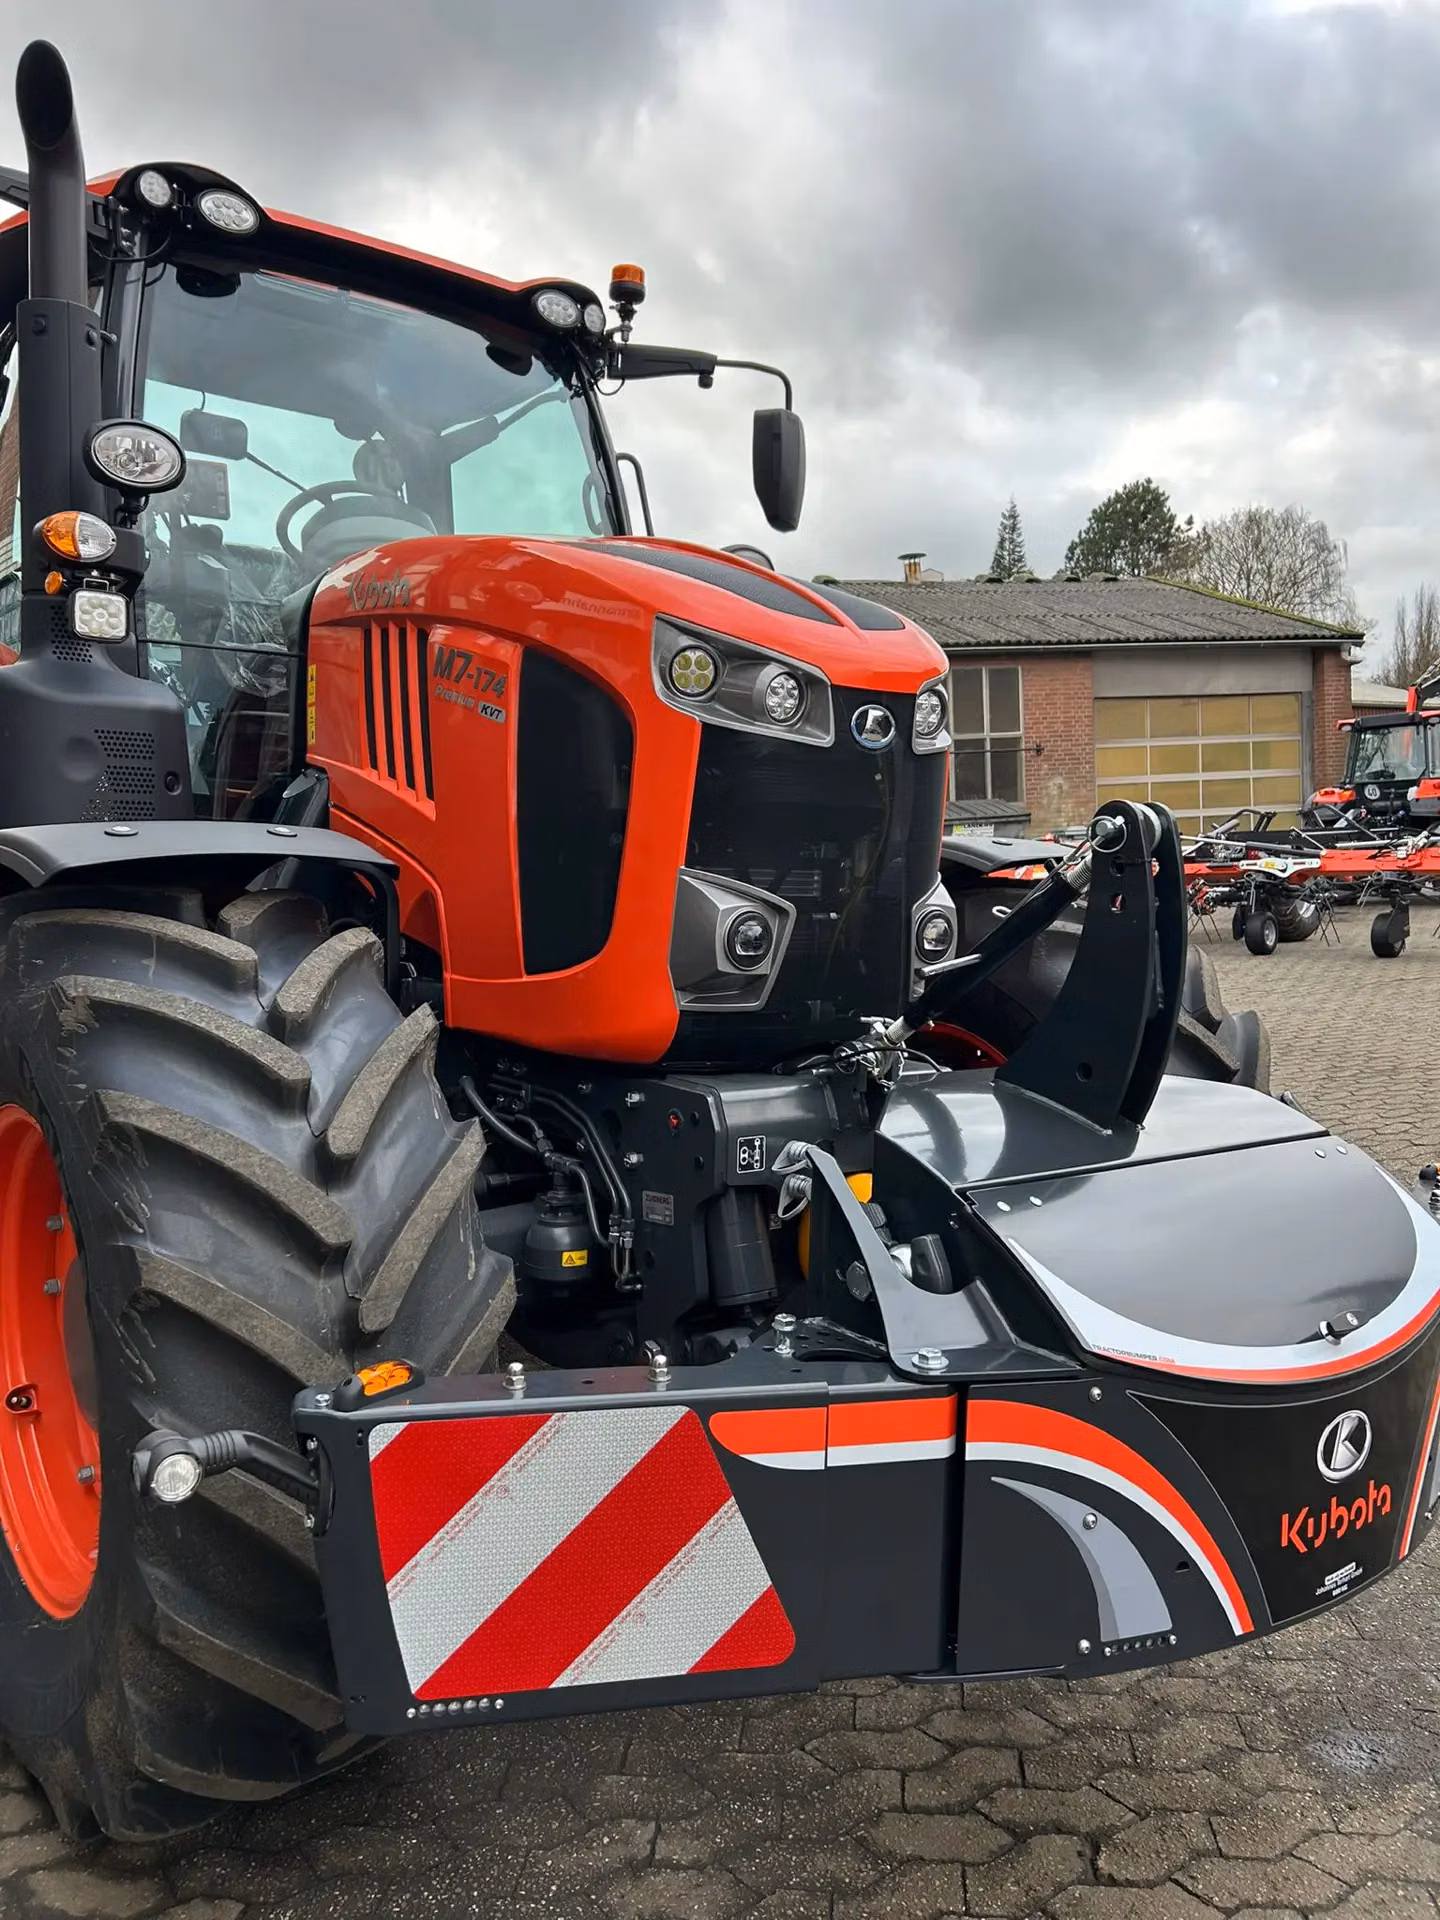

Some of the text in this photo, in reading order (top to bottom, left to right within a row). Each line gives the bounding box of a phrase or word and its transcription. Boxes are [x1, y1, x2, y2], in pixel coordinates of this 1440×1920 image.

[346, 569, 410, 610] Kubota
[433, 646, 507, 698] M7-174
[435, 684, 503, 720] Premium KVT
[1281, 1479, 1391, 1553] Kubota
